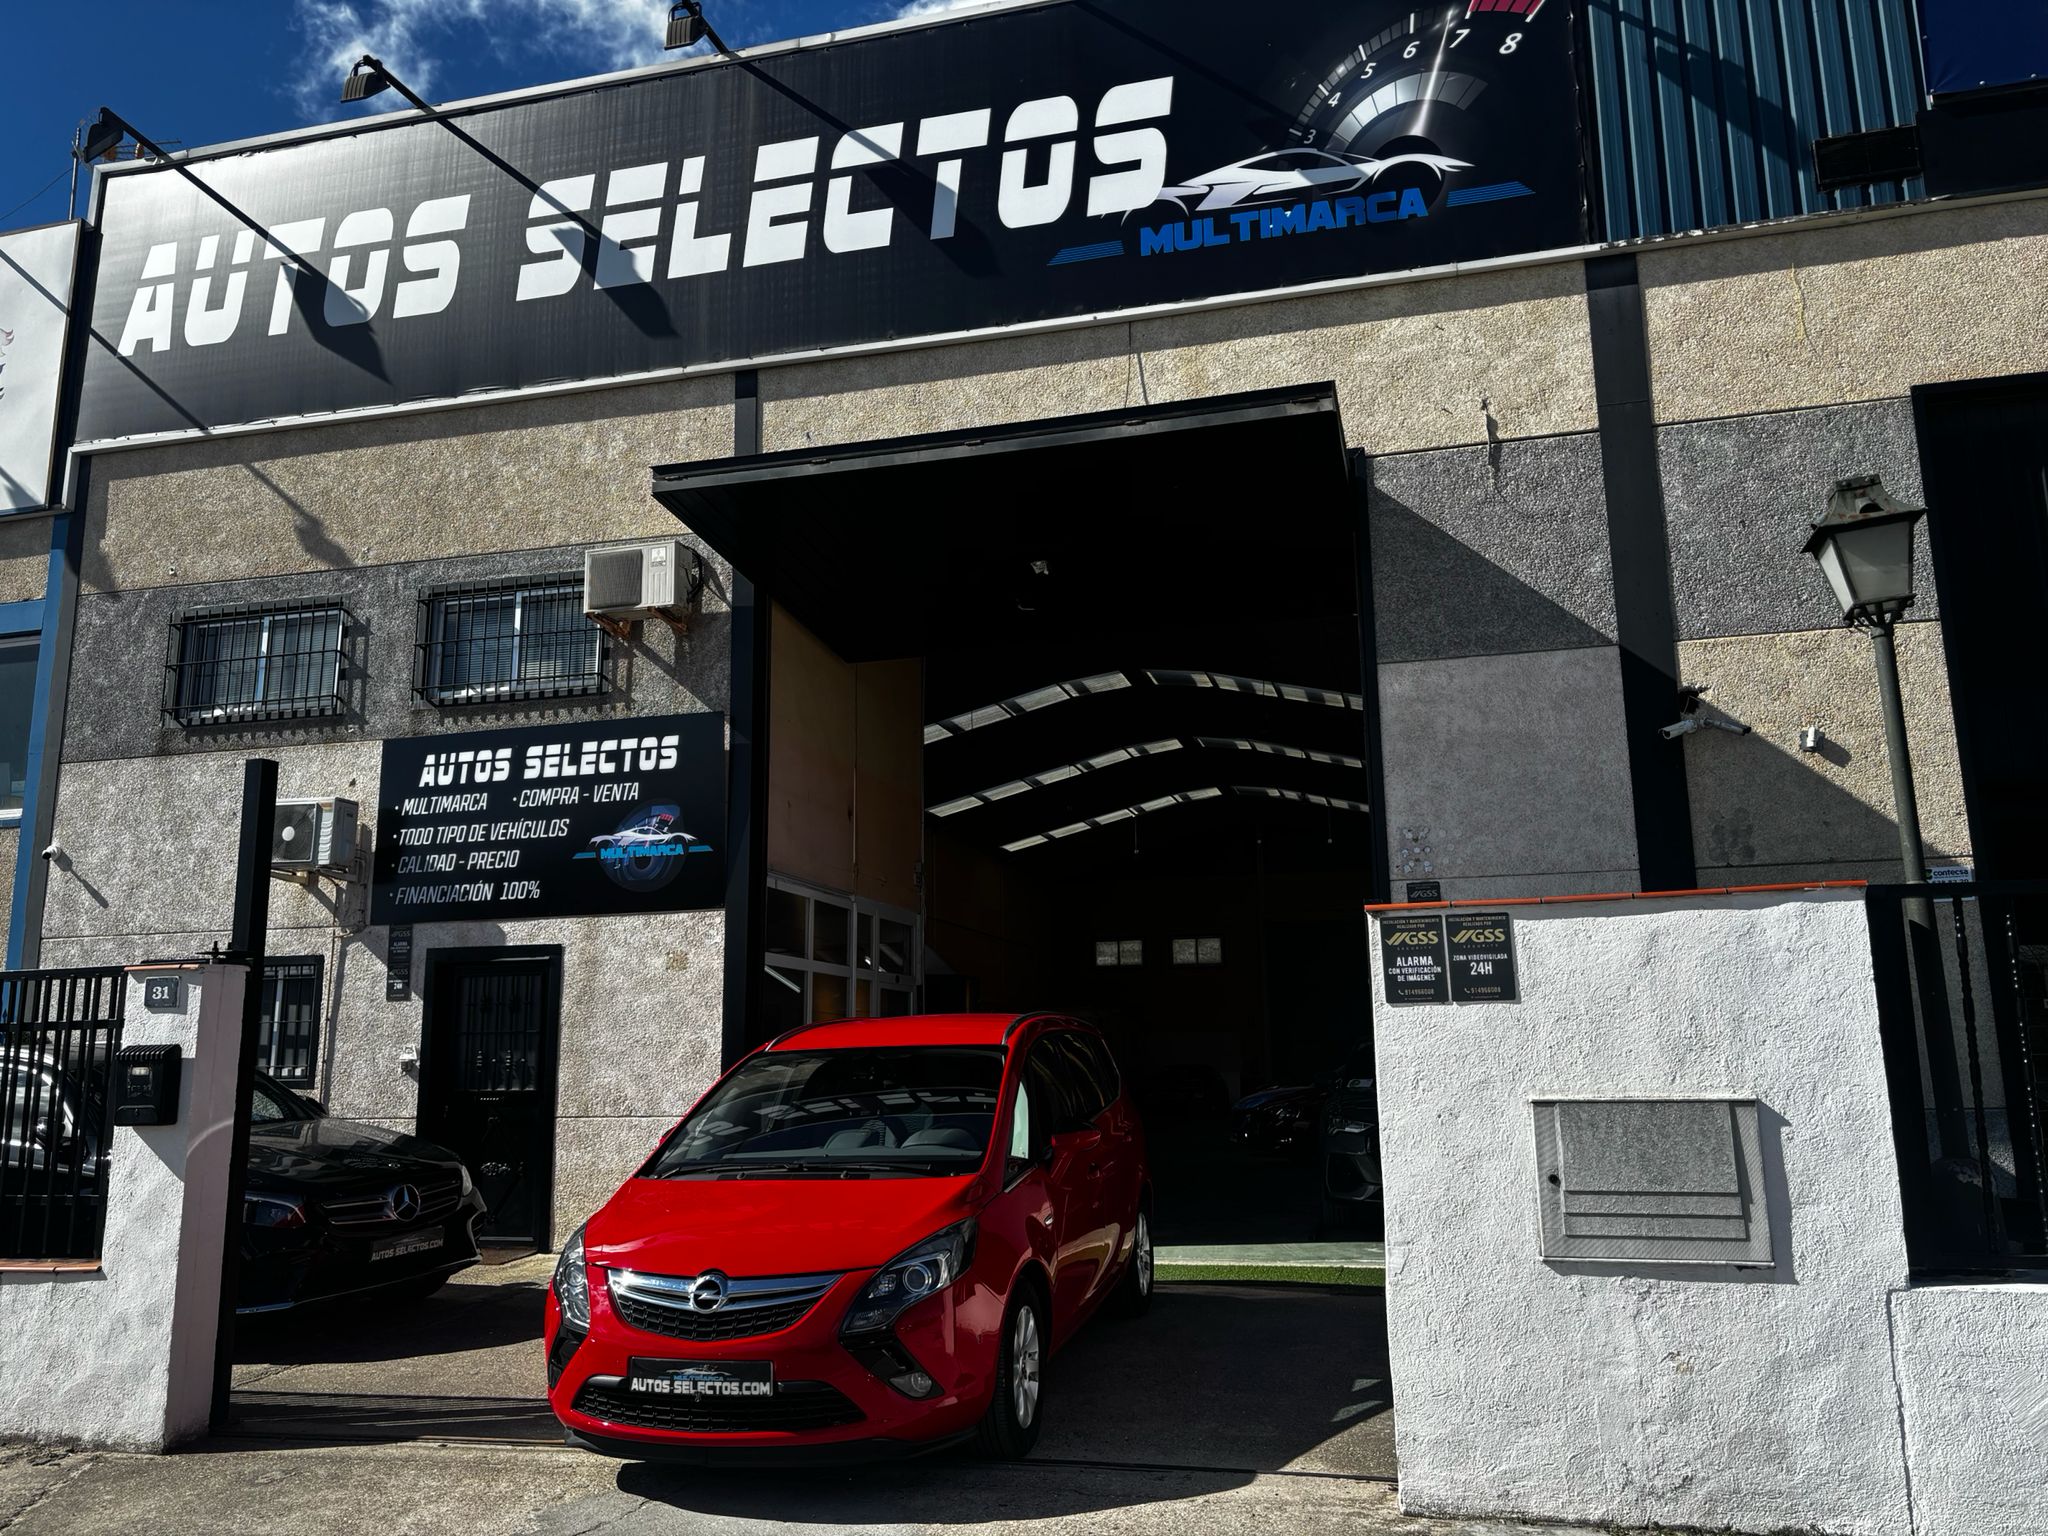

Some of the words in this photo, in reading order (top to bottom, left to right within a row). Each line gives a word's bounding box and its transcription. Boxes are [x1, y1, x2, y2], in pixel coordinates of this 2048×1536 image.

[1303, 129, 1317, 145] 3
[1328, 92, 1342, 108] 4
[1361, 62, 1377, 79] 5
[1403, 41, 1420, 59] 6
[1449, 29, 1471, 48] 7
[1499, 32, 1523, 54] 8
[114, 194, 471, 358] AUTOS
[516, 76, 1174, 302] SELECTOS
[1140, 187, 1429, 256] MULTIMARCA
[419, 748, 512, 787] AUTOS
[523, 735, 680, 780] SELECTOS
[401, 793, 488, 816] MULTIMARCA
[519, 786, 579, 808] COMPRA
[592, 782, 640, 803] VENTA
[399, 829, 435, 846] TODO
[436, 826, 468, 843] TIPO
[469, 824, 489, 842] DE
[491, 818, 570, 841] VEHÍCULOS
[397, 853, 455, 875] CALIDAD
[467, 850, 521, 870] PRECIO
[600, 844, 684, 860] MULTIMARCA
[395, 880, 493, 905] FINANCIACIÓN
[499, 880, 541, 900] 100%
[1388, 967, 1401, 975] CON
[1401, 965, 1442, 974] VERIFICACIÓN
[1396, 955, 1434, 967] ALARMA
[1470, 961, 1493, 975] 24H
[1397, 974, 1406, 982] DE
[1406, 973, 1435, 982] IMÁGENES
[152, 986, 169, 1000] 31
